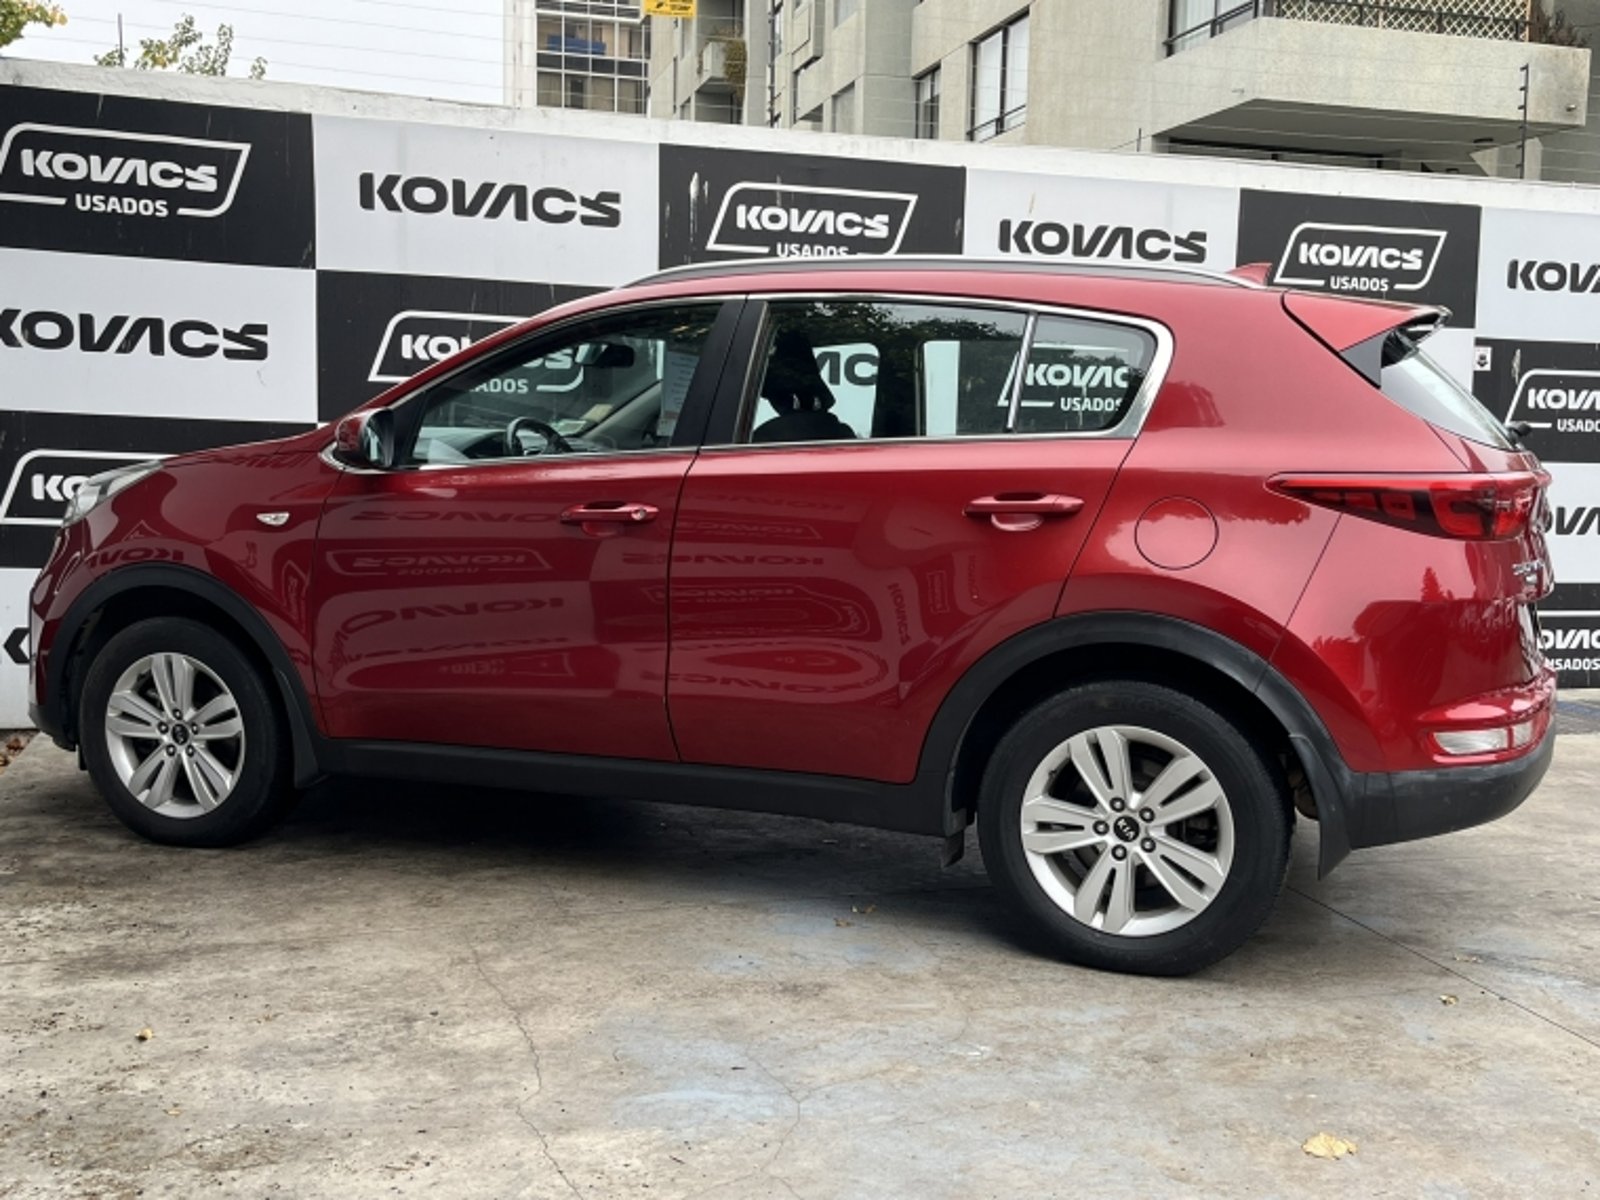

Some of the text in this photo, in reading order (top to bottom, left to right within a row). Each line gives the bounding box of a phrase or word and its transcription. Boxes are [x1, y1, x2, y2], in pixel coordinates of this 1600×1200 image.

[20, 149, 218, 192] KOVACS
[75, 193, 169, 218] USADOS
[359, 172, 621, 228] KOVACS
[736, 204, 889, 238] KOVACS
[998, 219, 1207, 264] KOVACS
[1299, 242, 1423, 270] KOVACS
[1329, 275, 1389, 292] USADOS
[1025, 363, 1129, 388] KOVAC
[1528, 388, 1600, 410] KOVA
